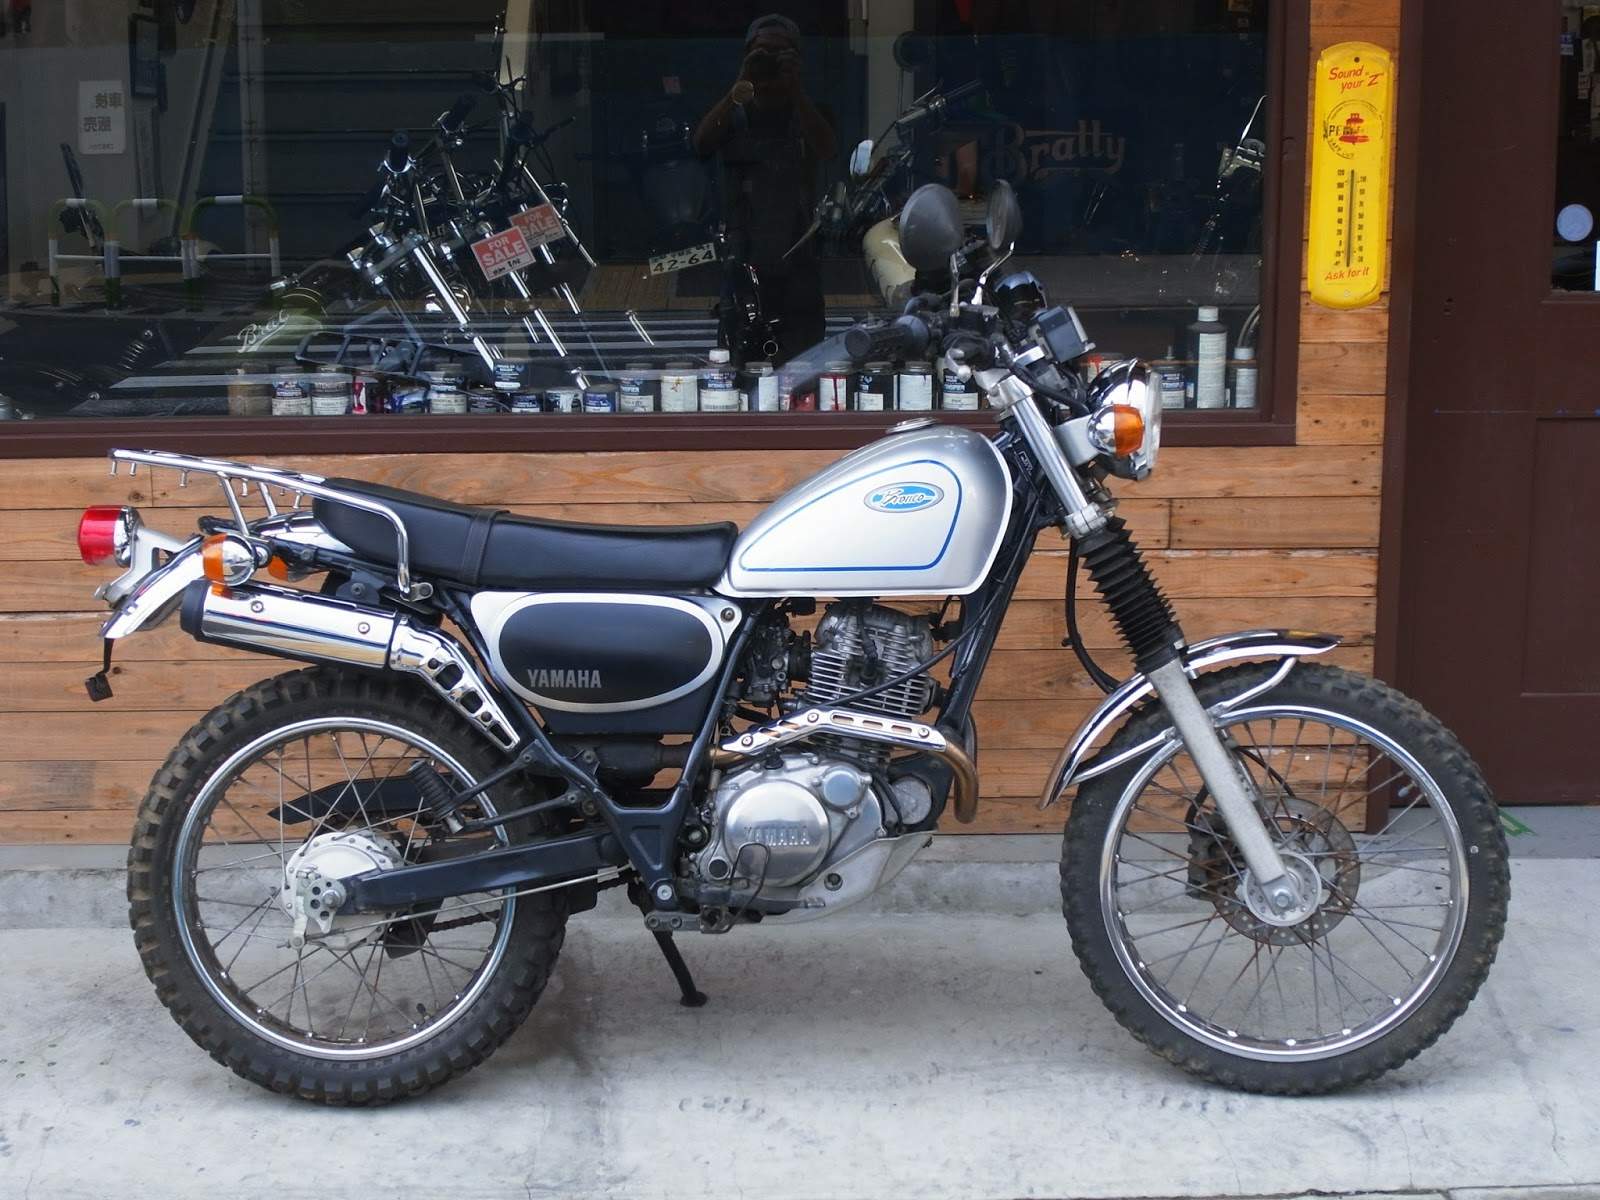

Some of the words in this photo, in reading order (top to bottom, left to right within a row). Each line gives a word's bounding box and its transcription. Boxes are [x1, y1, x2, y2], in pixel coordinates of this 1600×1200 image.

[1328, 65, 1365, 81] Sound
[1341, 80, 1364, 94] your
[525, 210, 543, 223] FOR
[520, 216, 556, 237] SALE
[488, 236, 510, 251] FOR
[482, 241, 526, 266] SALE
[1325, 271, 1345, 281] Ask
[1347, 268, 1361, 278] for
[527, 669, 602, 689] YAMAHA
[743, 825, 810, 847] YAMAHA
